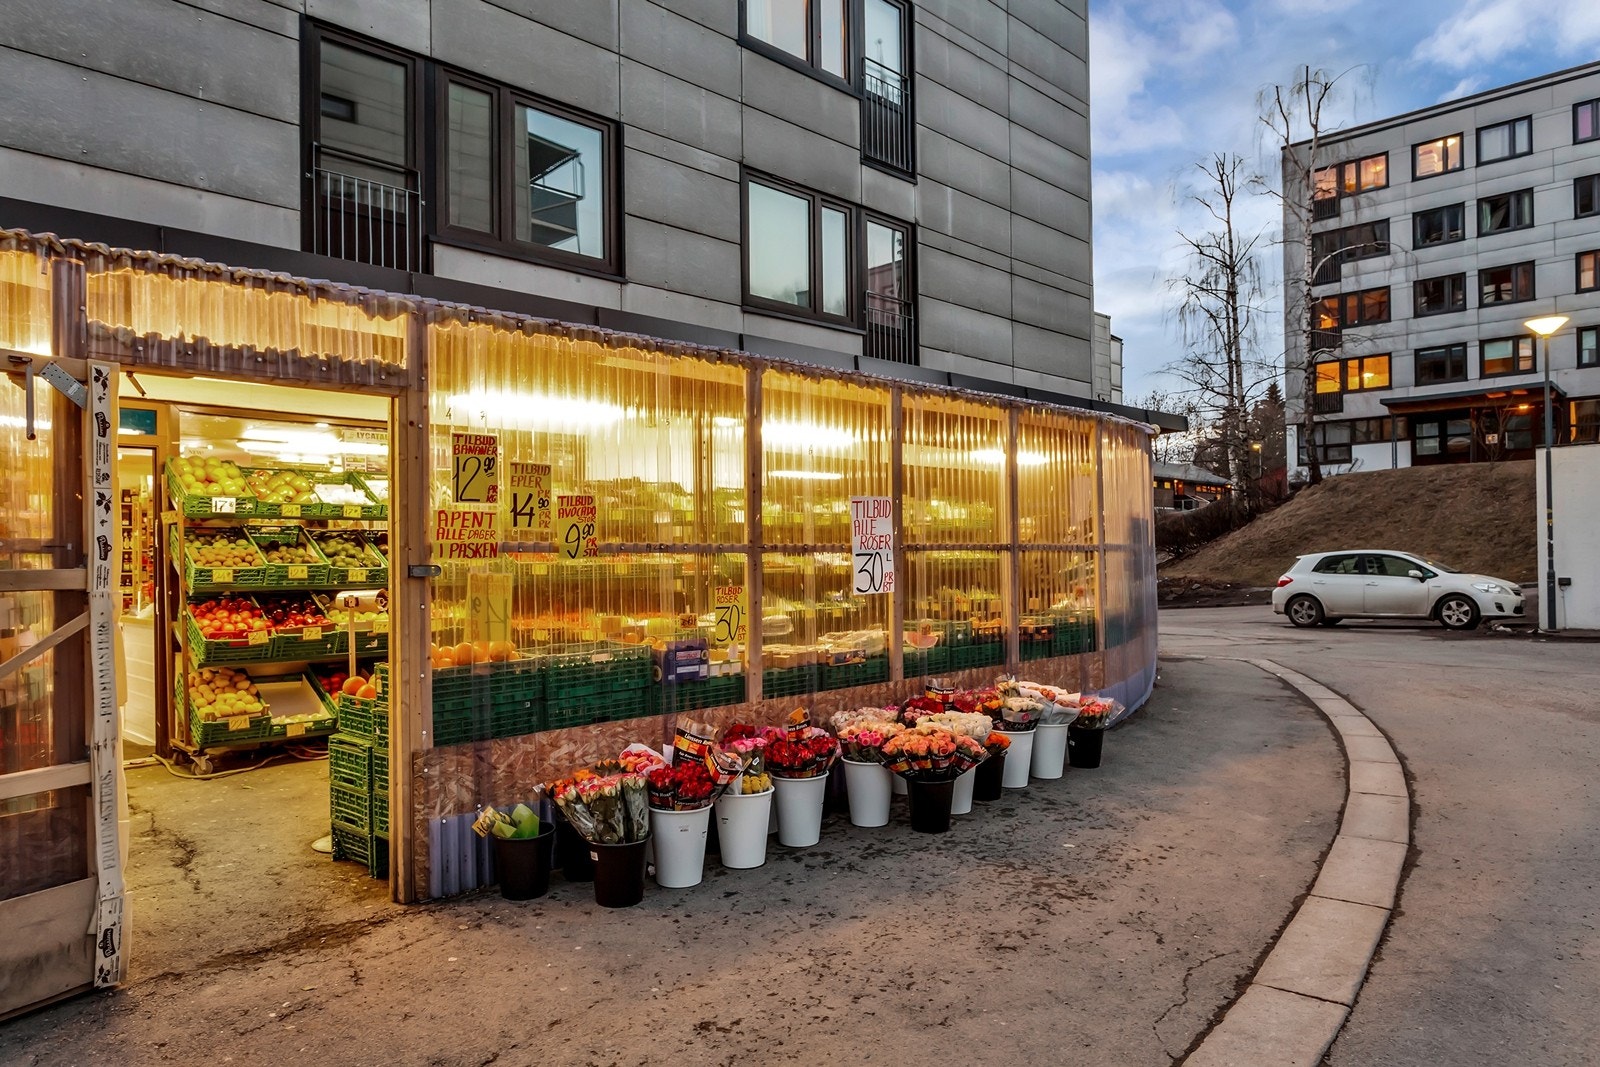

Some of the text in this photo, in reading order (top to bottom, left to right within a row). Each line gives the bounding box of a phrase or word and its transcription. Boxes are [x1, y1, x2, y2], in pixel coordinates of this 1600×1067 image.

[453, 434, 496, 446] TILBUD
[510, 463, 551, 476] TILBUD
[452, 456, 481, 502] 12
[510, 475, 542, 490] EPLER
[487, 485, 498, 495] PR
[213, 500, 228, 512] 17
[557, 495, 593, 507] TILBUD
[510, 492, 549, 528] 14 90
[538, 510, 552, 520] PR
[558, 505, 597, 519] AVOCADO
[852, 499, 891, 519] TILBUD
[436, 527, 496, 541] ALLE DAGER
[565, 523, 595, 559] 9 90
[586, 537, 598, 549] PR
[859, 533, 892, 551] ROSER
[439, 541, 498, 559] I PÅSKEN
[582, 548, 599, 558] STK
[855, 551, 884, 594] 30
[884, 571, 894, 582] PR
[715, 586, 743, 596] TILBUD
[882, 581, 893, 593] BT
[716, 595, 740, 605] ROSER
[715, 604, 740, 642] 30
[737, 624, 747, 634] PR
[737, 633, 746, 641] BT
[97, 621, 112, 717] FRUITMASTERS
[100, 773, 116, 871] FRUITMASTERS
